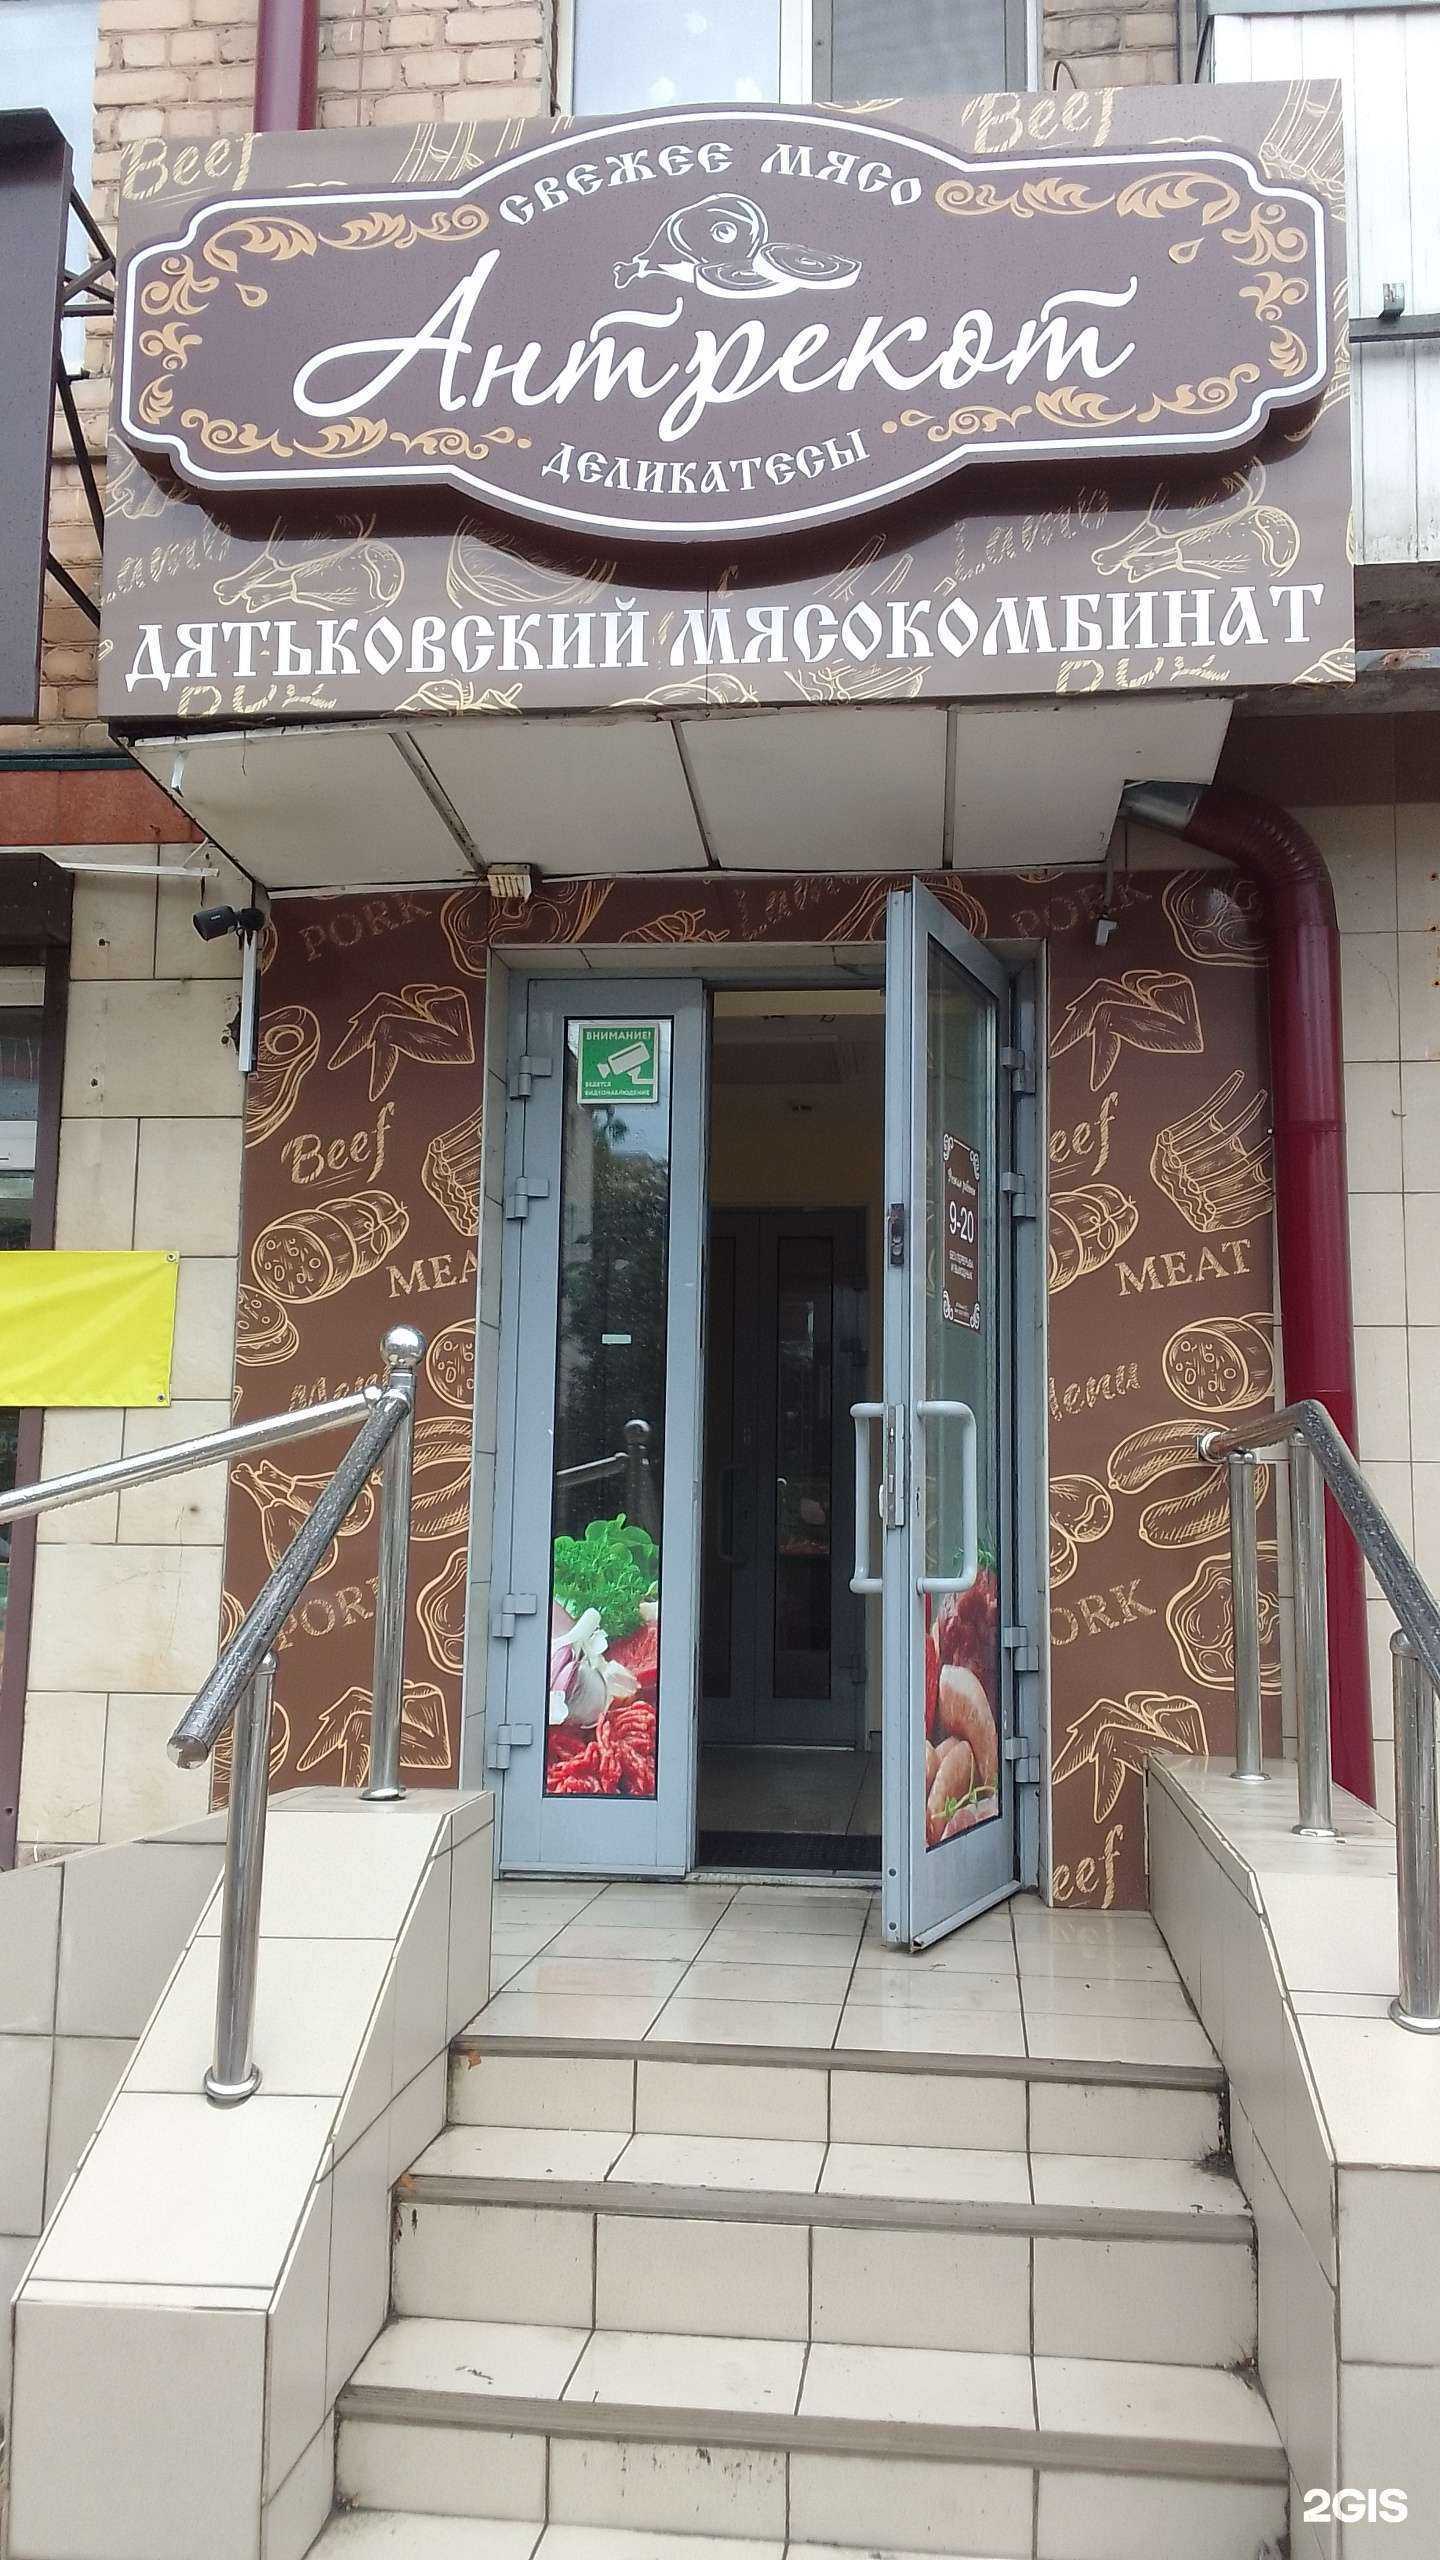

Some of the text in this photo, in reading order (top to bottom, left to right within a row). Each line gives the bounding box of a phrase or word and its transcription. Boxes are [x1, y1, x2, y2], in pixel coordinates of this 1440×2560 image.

[500, 141, 922, 226] СВЕЖЕЕ МЯСО
[293, 248, 1139, 443] Антрекот
[541, 428, 871, 495] ДЕЛИКАТЕСЫ
[124, 583, 1325, 693] ДЯТЬКОВСКИЙ МЯСОКОМБИНАТ
[586, 1031, 652, 1041] ВНИМАНИЕ!
[281, 1101, 395, 1184] Beef
[949, 1200, 974, 1244] 9-20
[1115, 1239, 1251, 1296] MEAT
